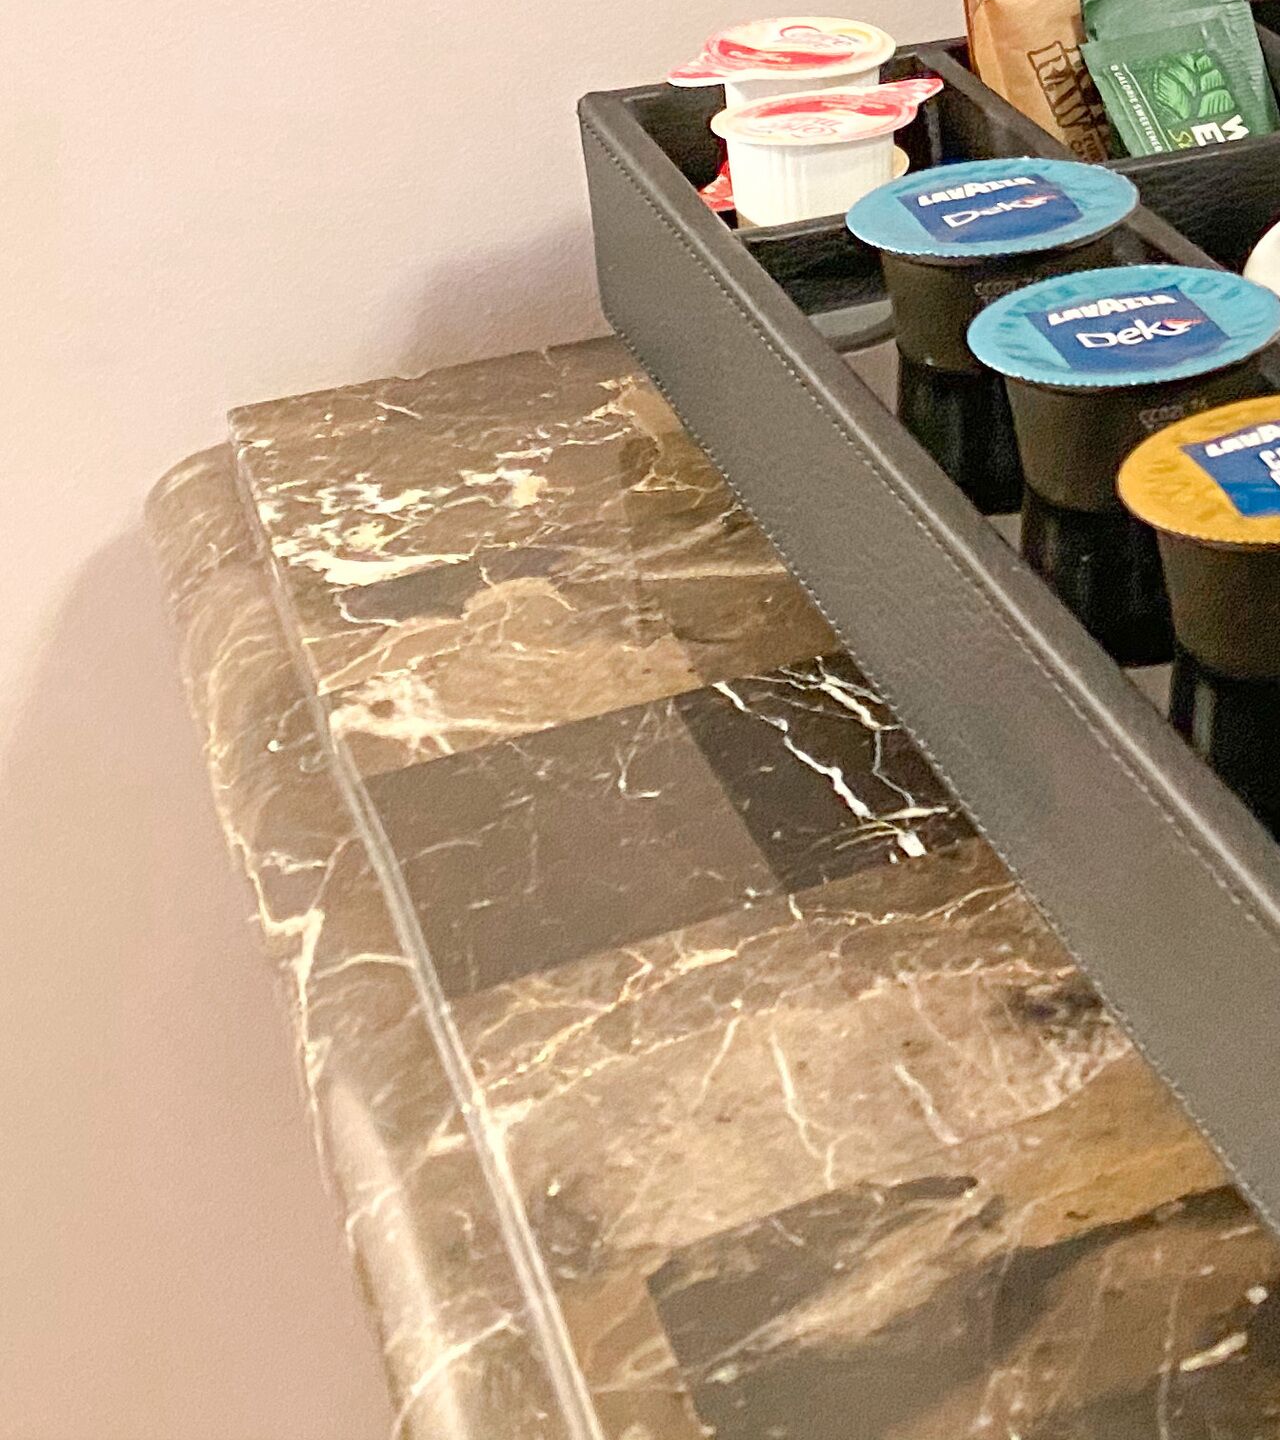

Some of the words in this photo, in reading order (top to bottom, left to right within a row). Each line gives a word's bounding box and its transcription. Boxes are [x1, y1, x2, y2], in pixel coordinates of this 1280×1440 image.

[1027, 41, 1094, 128] RAW
[918, 177, 1036, 207] LAVAZZA
[1048, 295, 1178, 326] LAVAZZA
